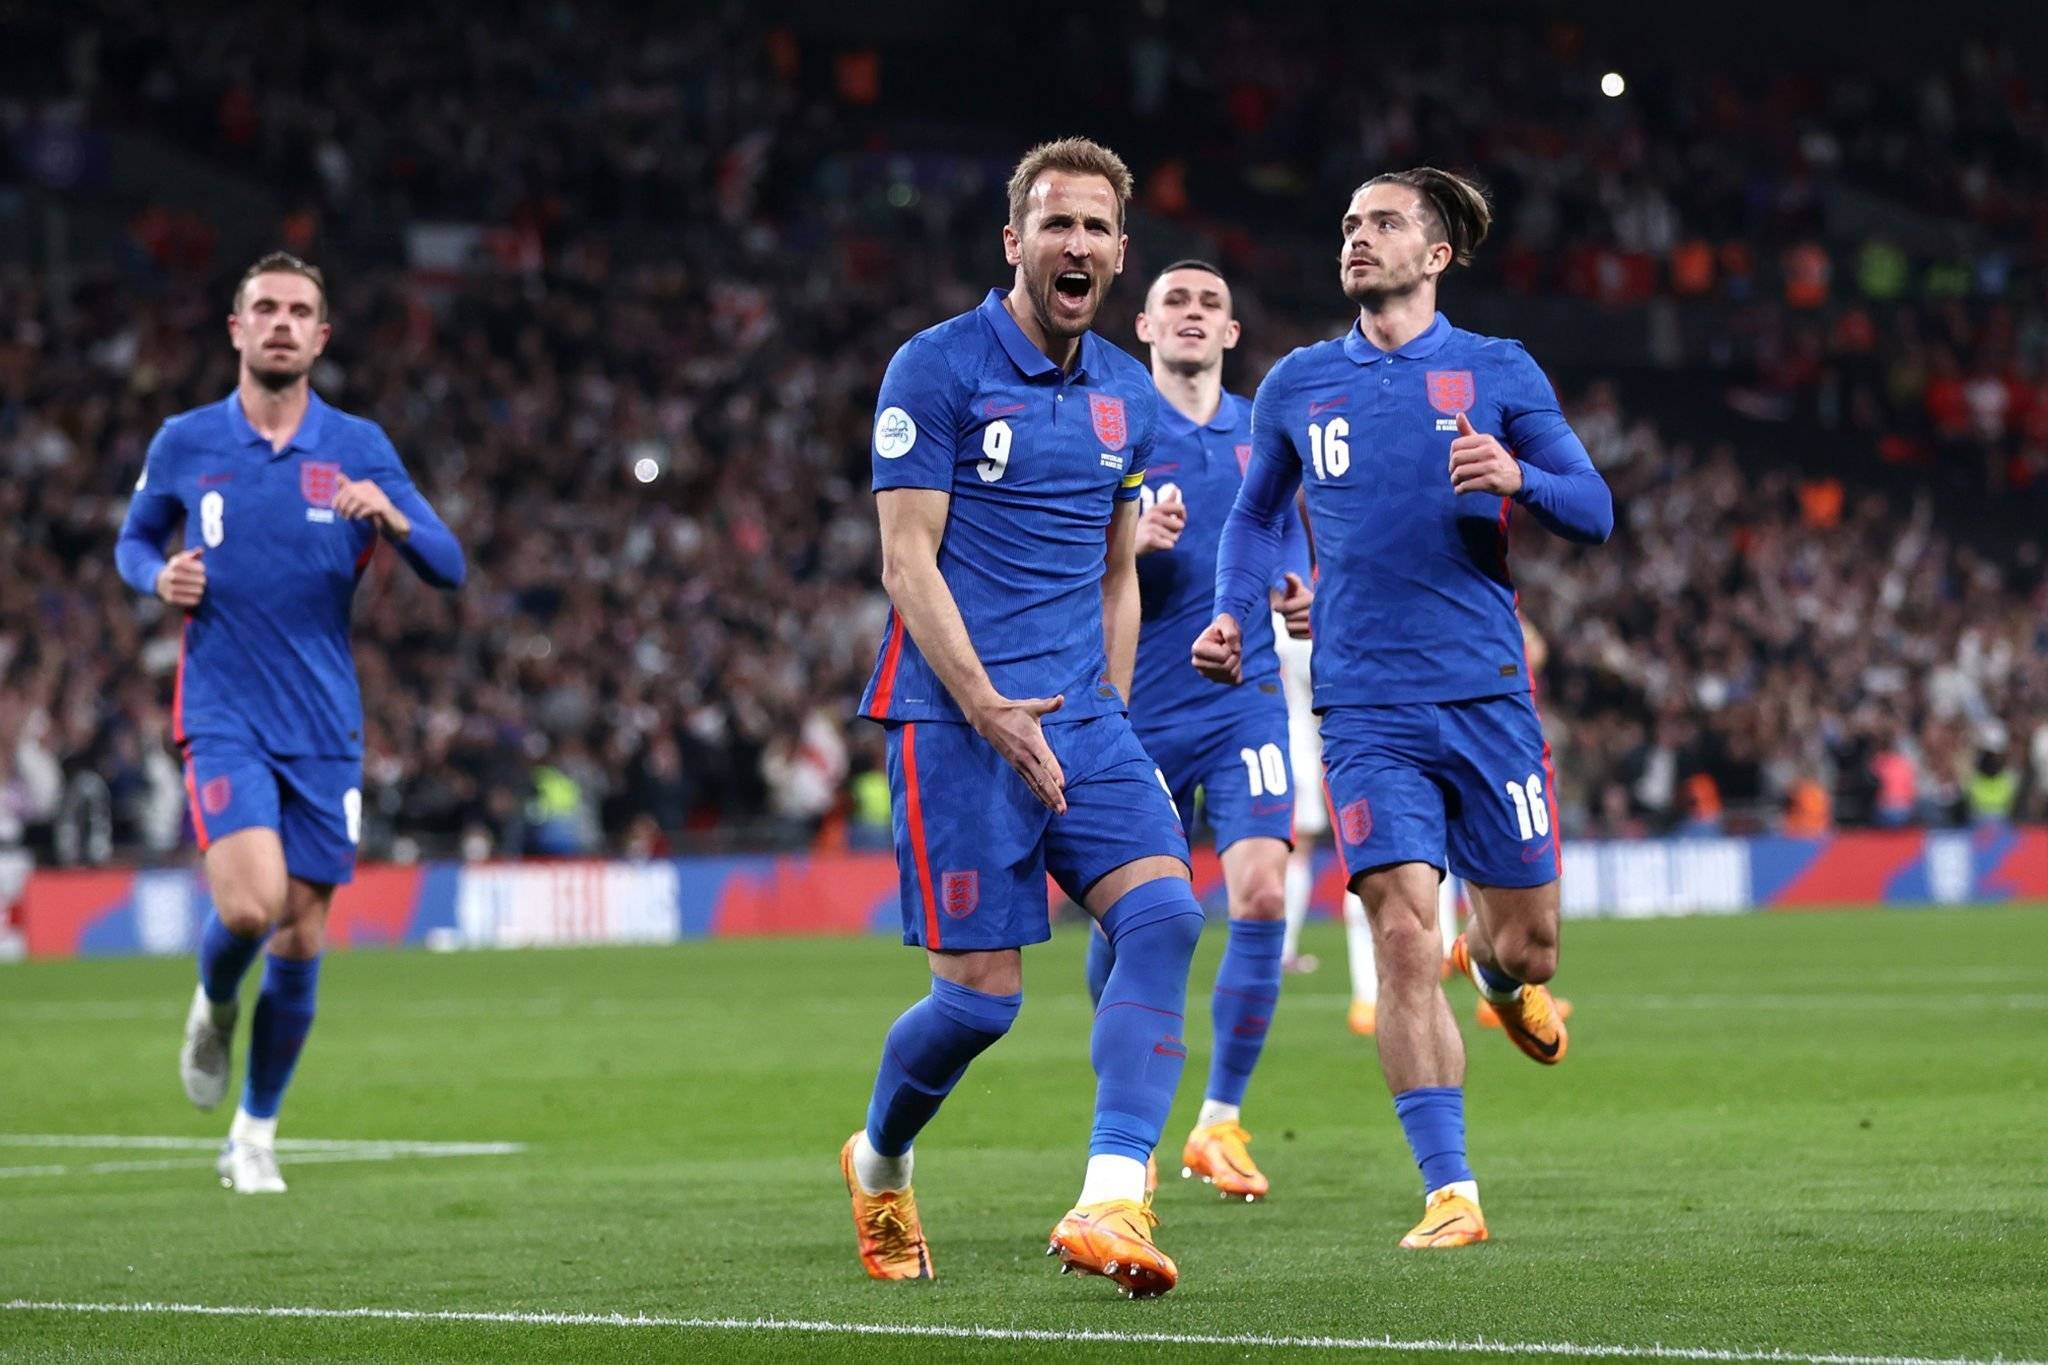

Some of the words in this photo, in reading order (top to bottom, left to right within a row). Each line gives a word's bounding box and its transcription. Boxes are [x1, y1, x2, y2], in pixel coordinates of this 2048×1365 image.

[976, 420, 1012, 483] 9
[1307, 416, 1351, 480] 16
[200, 490, 224, 548] 8
[1240, 742, 1288, 797] 10
[1506, 773, 1549, 841] 16
